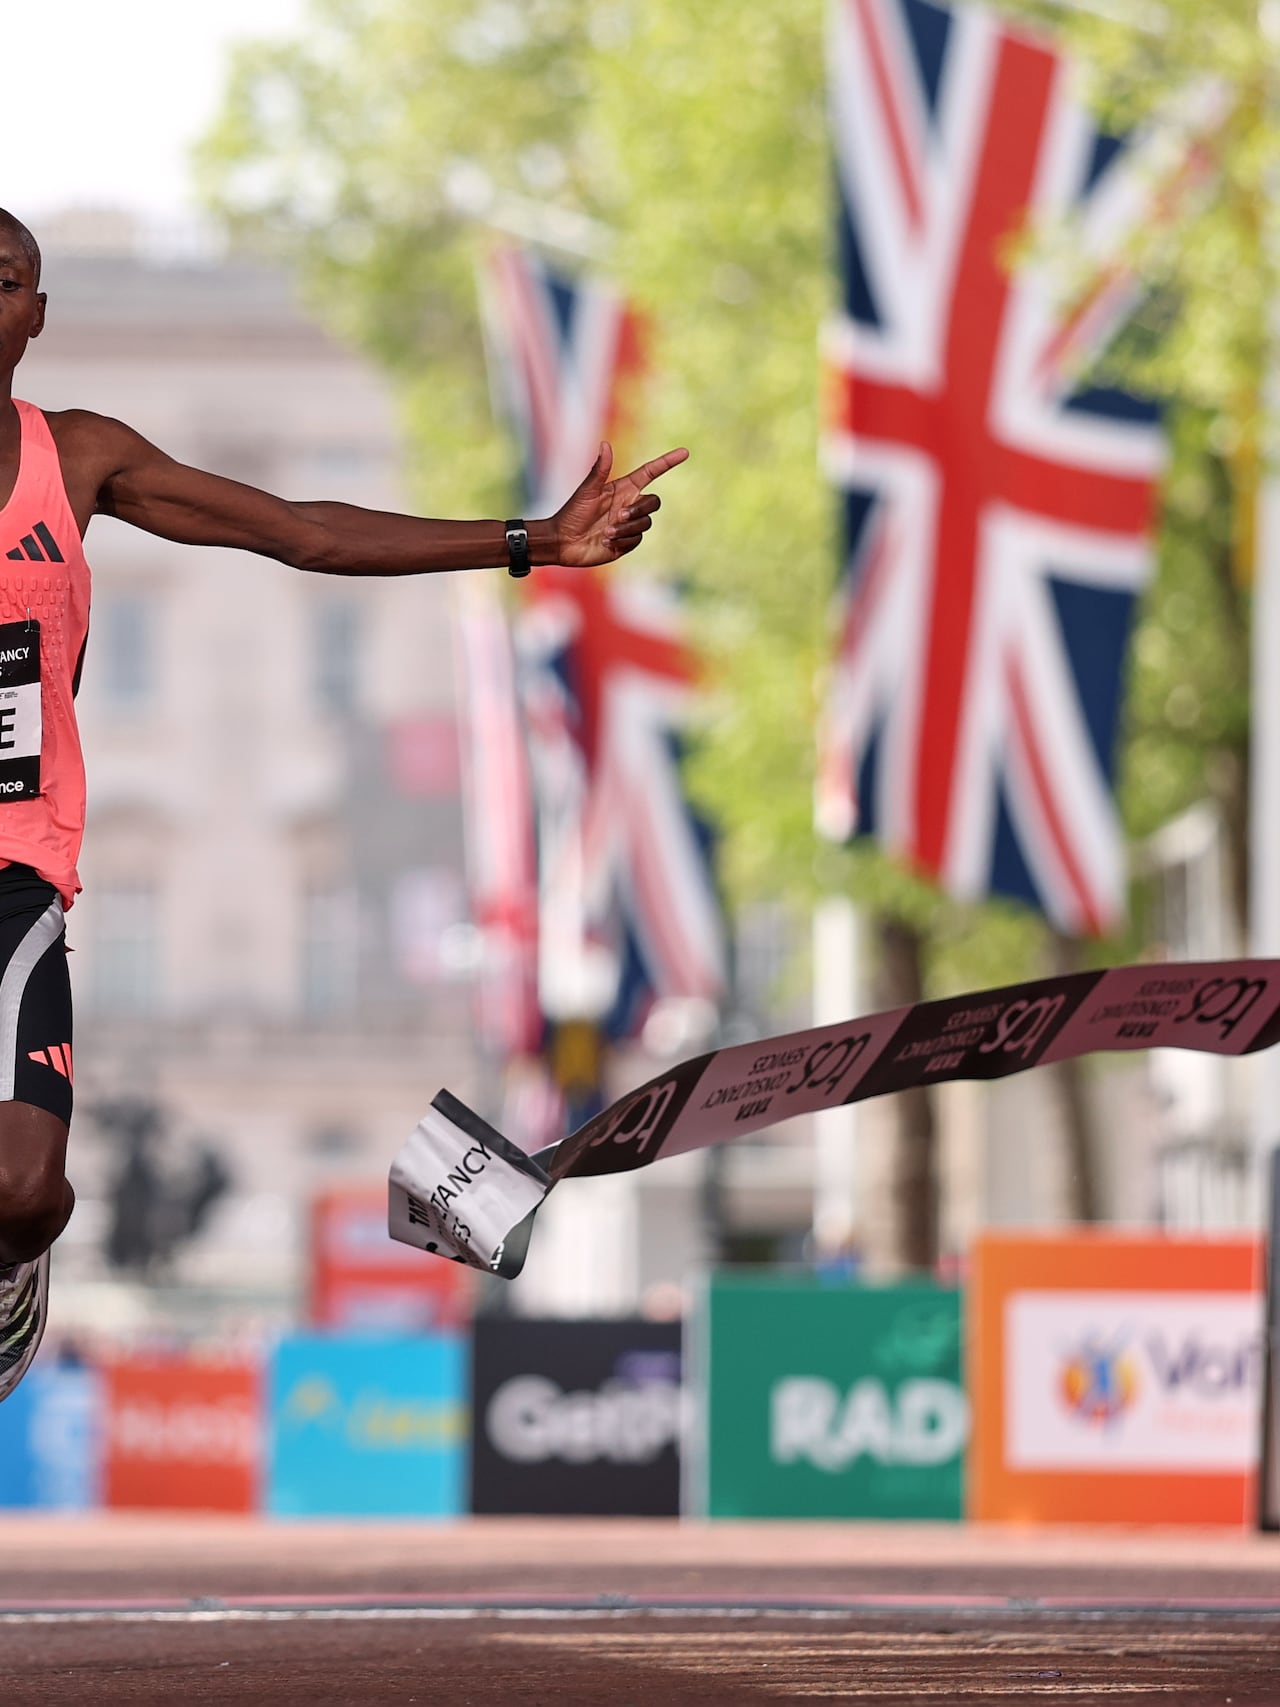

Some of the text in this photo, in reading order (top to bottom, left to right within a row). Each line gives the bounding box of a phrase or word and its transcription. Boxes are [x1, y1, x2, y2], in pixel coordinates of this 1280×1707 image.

[979, 994, 1067, 1060] tcs
[1174, 976, 1267, 1041] tcs
[748, 1046, 810, 1076] SERVICES
[786, 1032, 872, 1096] tcs
[700, 1071, 791, 1111] CONSULTANCY
[734, 1098, 774, 1122] TATA
